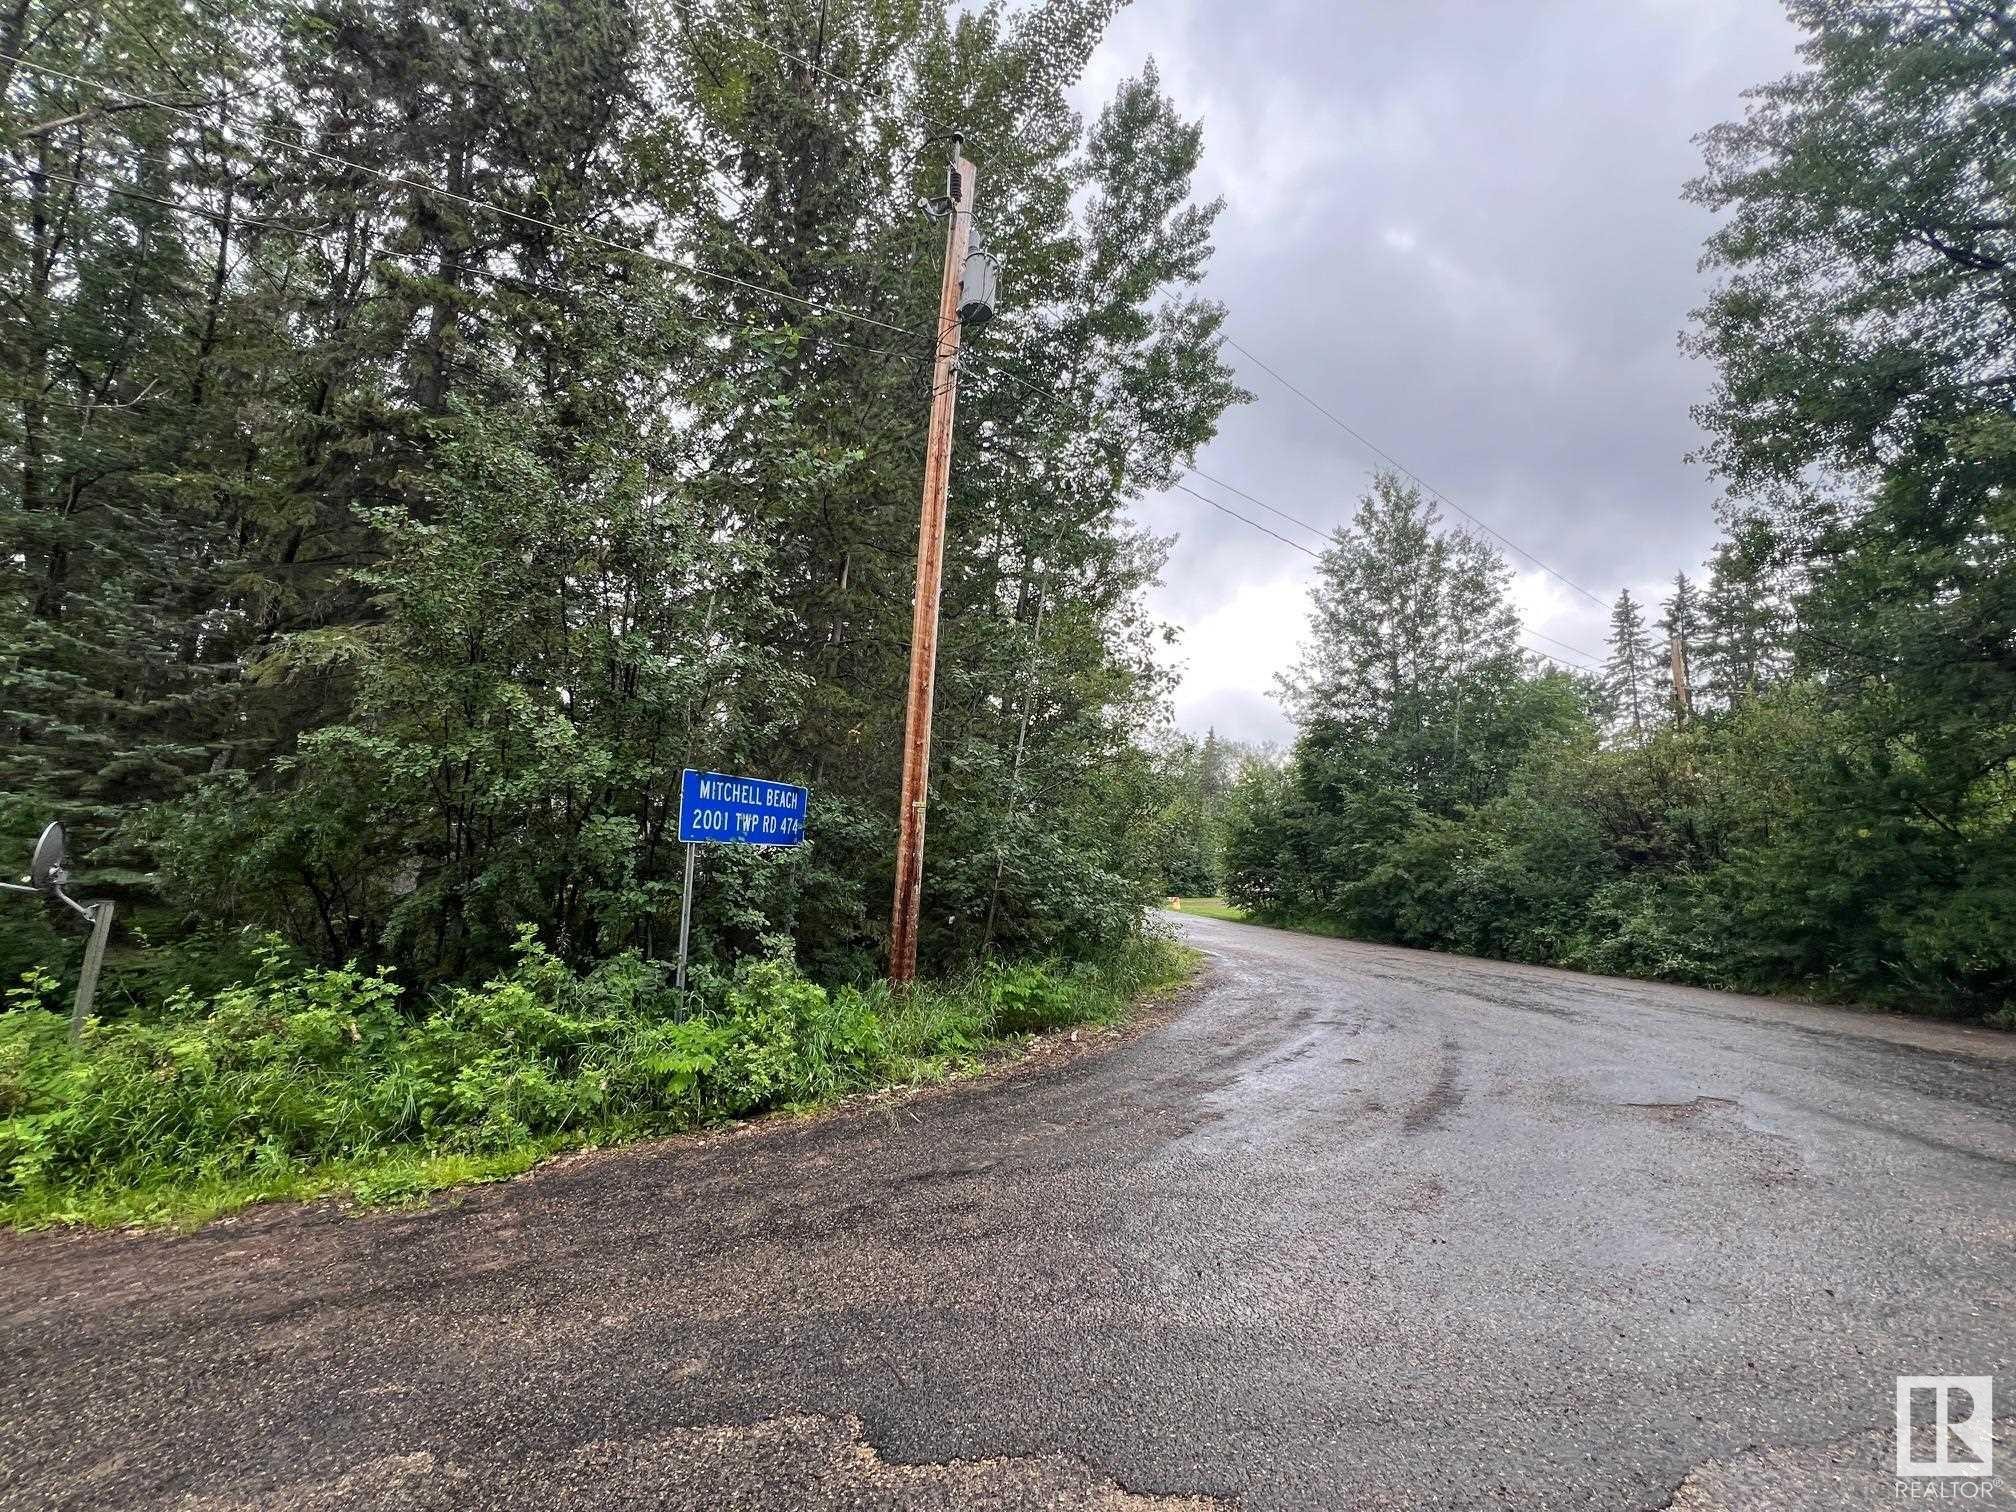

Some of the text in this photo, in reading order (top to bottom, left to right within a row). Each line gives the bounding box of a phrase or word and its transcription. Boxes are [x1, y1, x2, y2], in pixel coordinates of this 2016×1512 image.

[700, 780, 798, 809] MITCHELL BEACH
[692, 809, 798, 835] 2001 TWP RD 474
